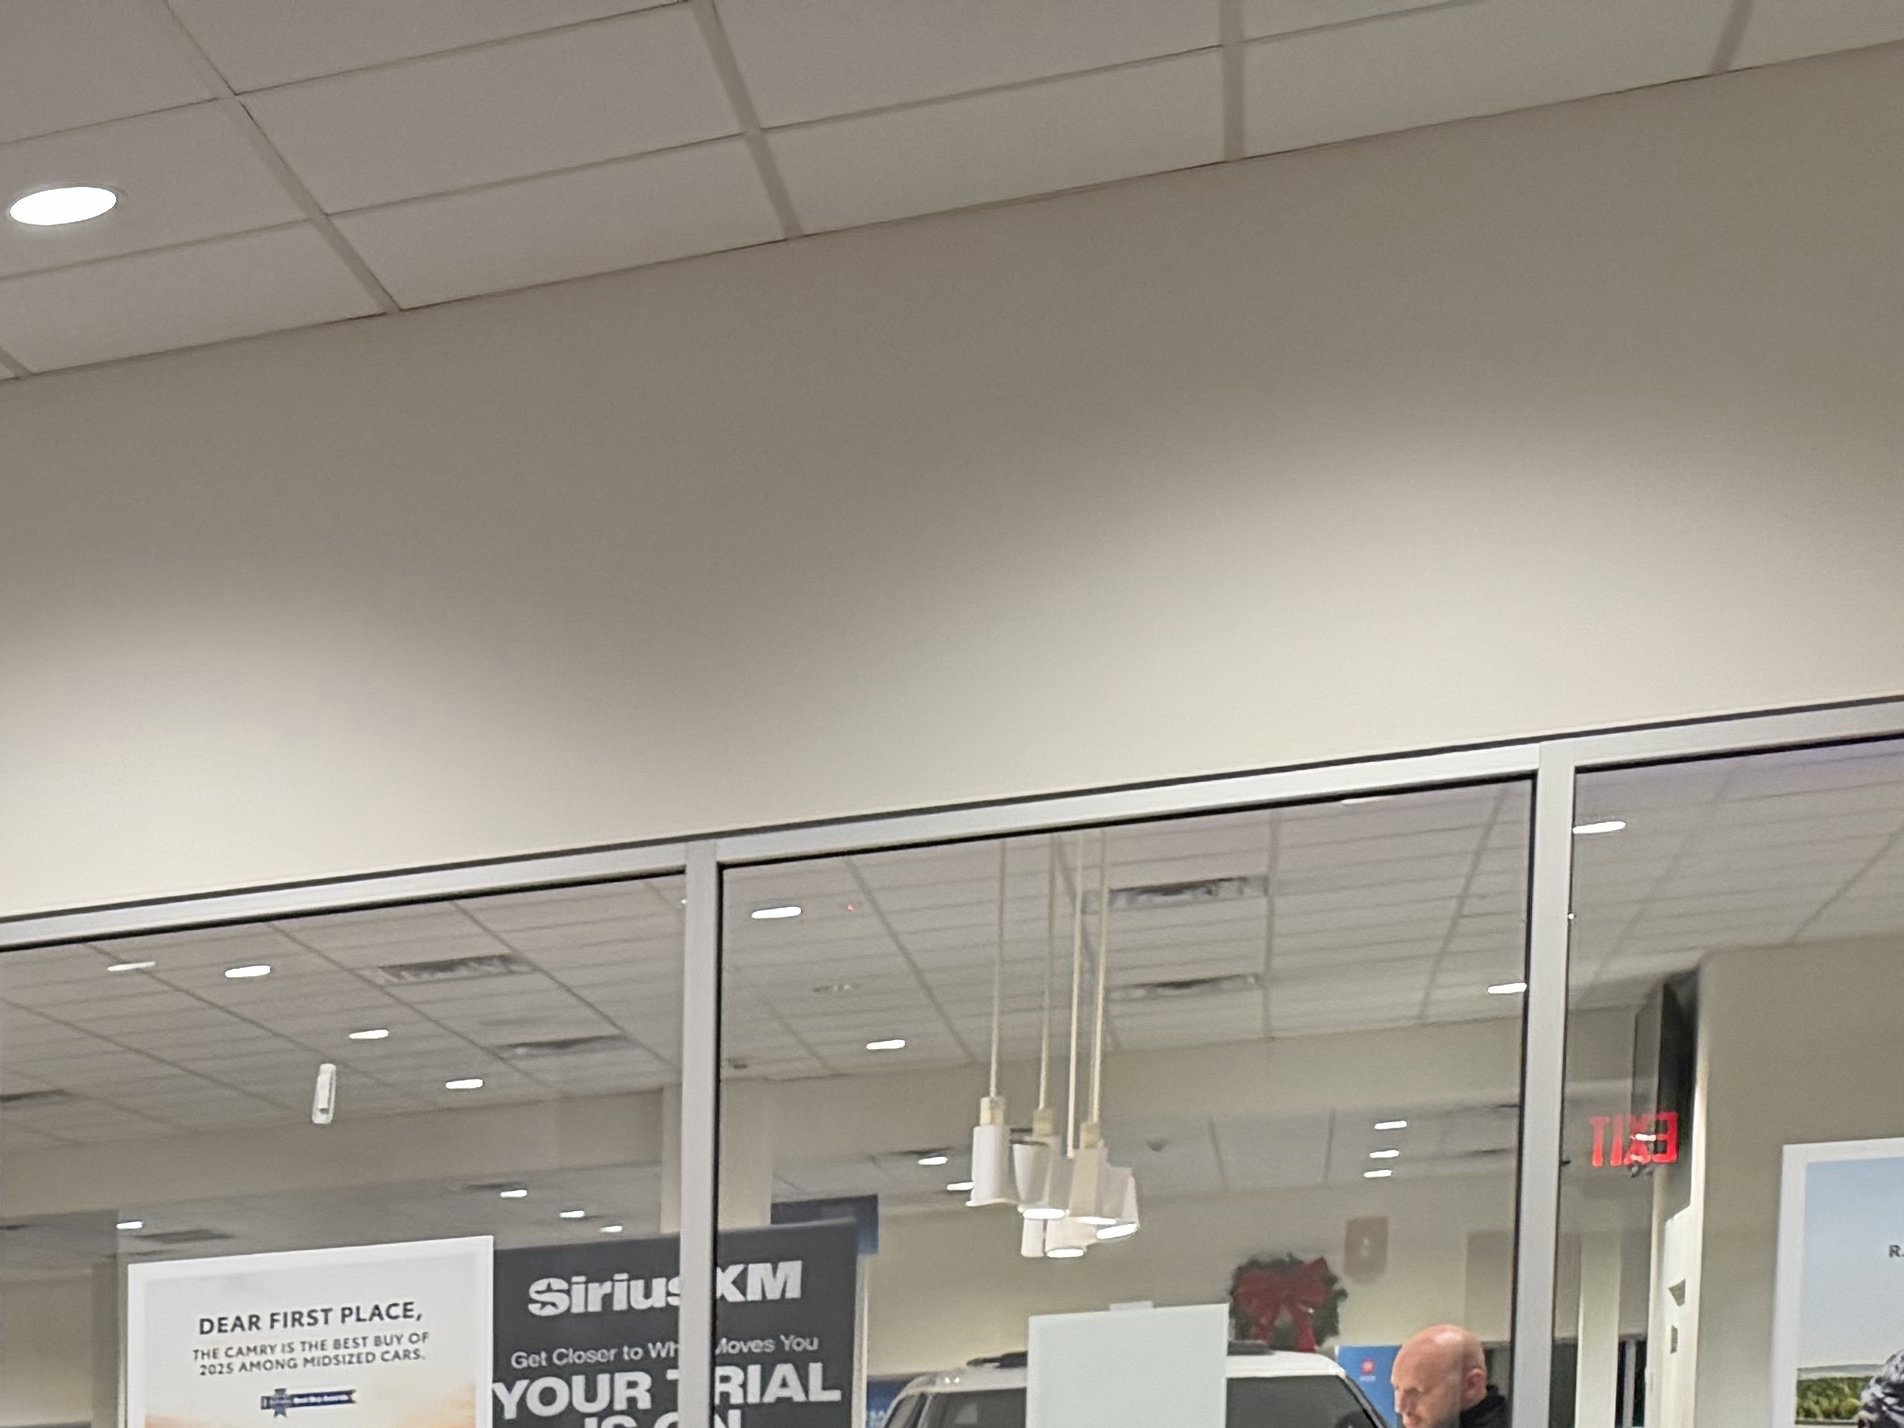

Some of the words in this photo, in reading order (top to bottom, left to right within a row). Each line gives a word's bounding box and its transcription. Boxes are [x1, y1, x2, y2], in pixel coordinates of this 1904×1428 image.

[198, 1313, 262, 1336] DEAR
[269, 1308, 333, 1330] FIRST
[340, 1301, 423, 1325] PLACE,
[193, 1348, 219, 1361] THE
[224, 1344, 278, 1359] CAMRY
[280, 1342, 295, 1354] IS
[300, 1339, 328, 1352] THE
[333, 1335, 369, 1350] BEST
[374, 1333, 404, 1347] BUY
[408, 1331, 430, 1345] OF
[199, 1363, 234, 1376] 2025
[238, 1358, 298, 1373] AMONG
[303, 1351, 376, 1369] MIDSIZED
[381, 1348, 426, 1363] CARS.
[511, 1350, 547, 1370] Get
[553, 1345, 616, 1366] Closer
[623, 1344, 643, 1362] to
[647, 1341, 680, 1360] Wh
[779, 1334, 819, 1352] You
[492, 1370, 653, 1420] YOUR
